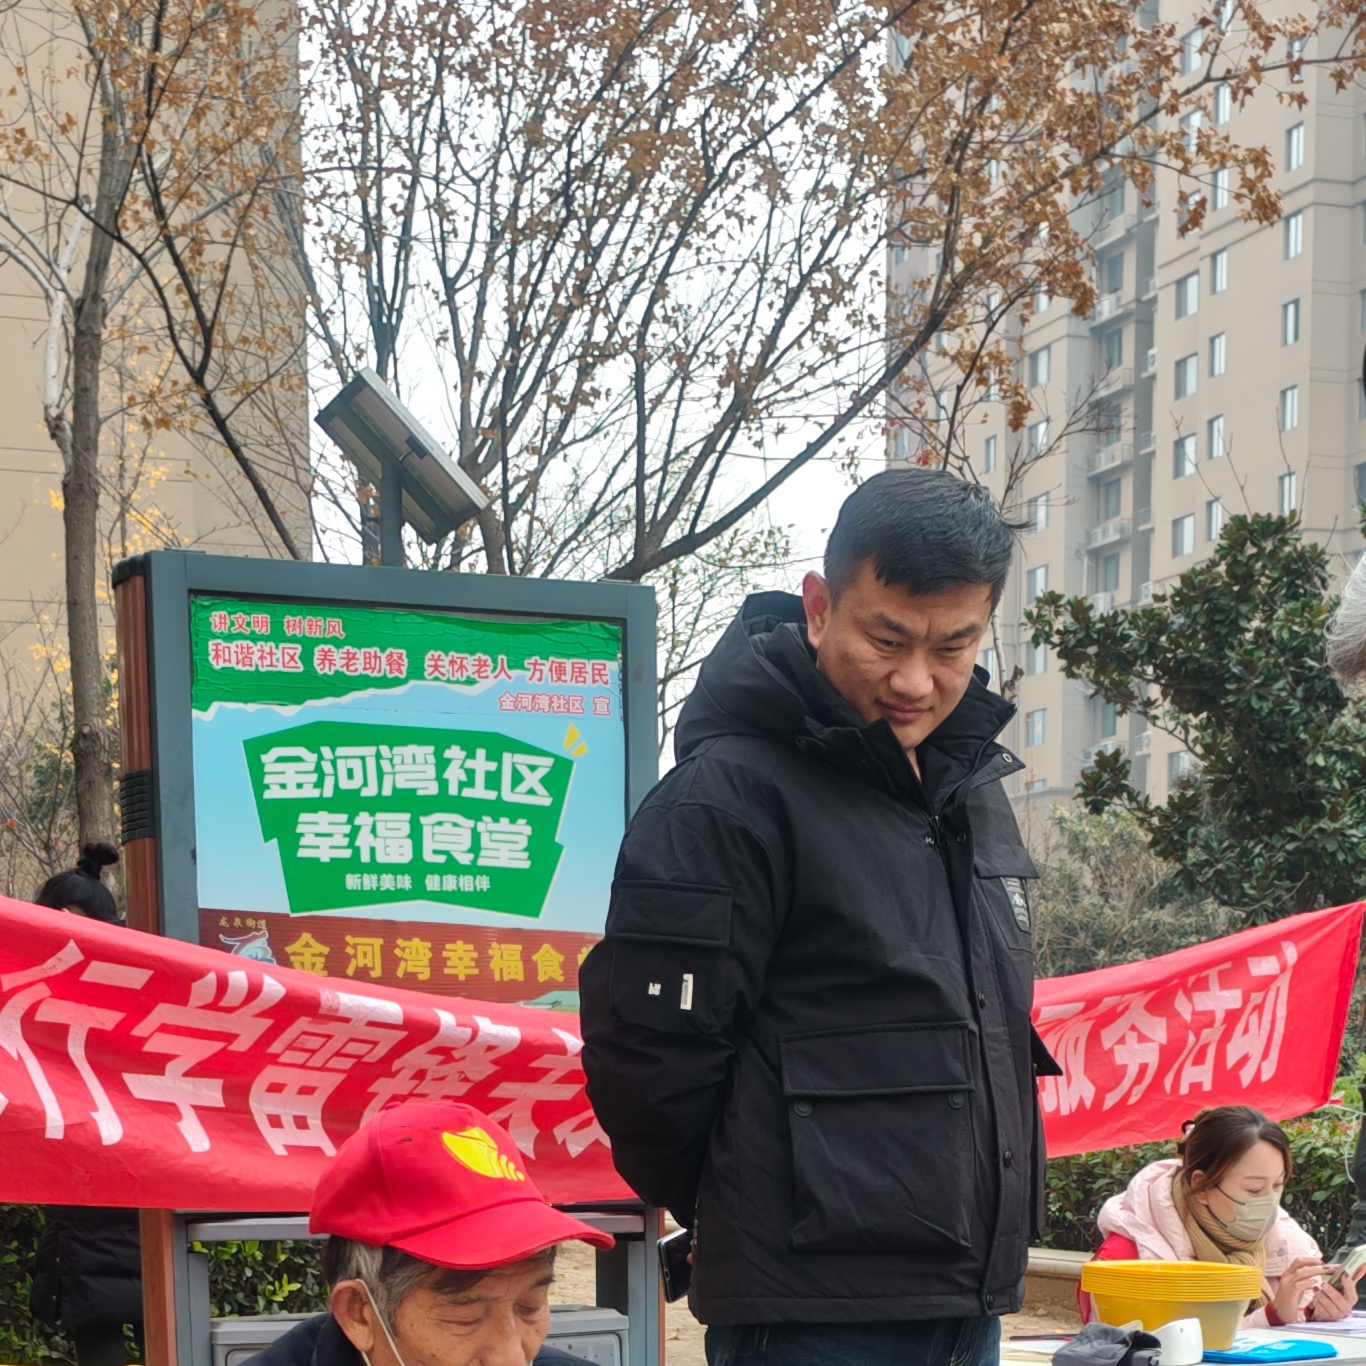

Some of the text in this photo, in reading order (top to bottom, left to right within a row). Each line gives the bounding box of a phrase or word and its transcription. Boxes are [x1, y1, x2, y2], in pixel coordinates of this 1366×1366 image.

[210, 611, 345, 639] 讲文明 树新风
[210, 641, 610, 686] 和谐社区 养老助餐 关怀老人 方便居民
[499, 690, 611, 716] 金河湾社区 宣
[260, 744, 555, 806] 金河湾社区
[295, 811, 533, 869] 幸福食堂
[345, 873, 491, 892] 新鲜美味 健康相伴
[285, 932, 585, 983] 金河湾幸福食
